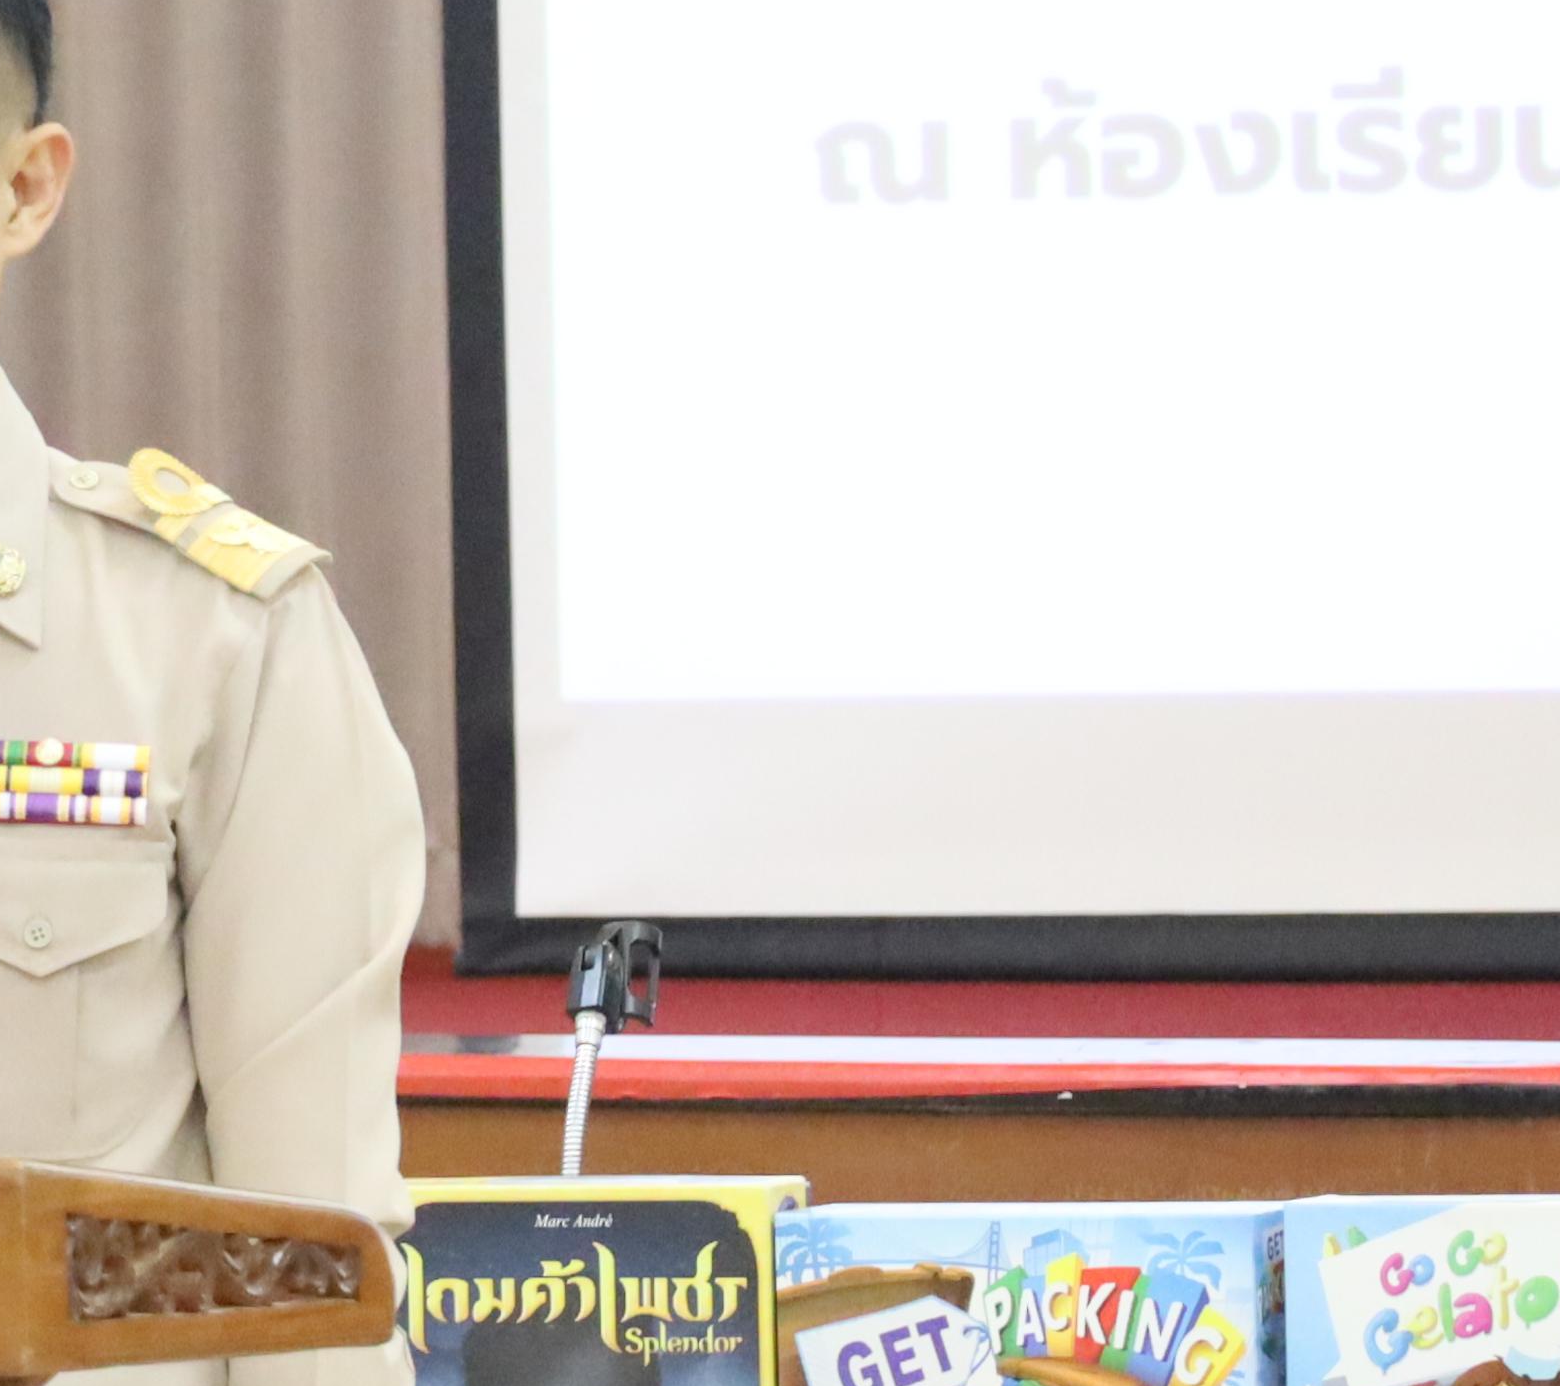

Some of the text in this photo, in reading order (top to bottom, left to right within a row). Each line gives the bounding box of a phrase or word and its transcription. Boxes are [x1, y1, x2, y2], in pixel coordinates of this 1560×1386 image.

[814, 121, 951, 205] ณ
[534, 1214, 570, 1228] Marc
[625, 1321, 743, 1367] Splendor
[984, 1281, 1226, 1386] PACKING
